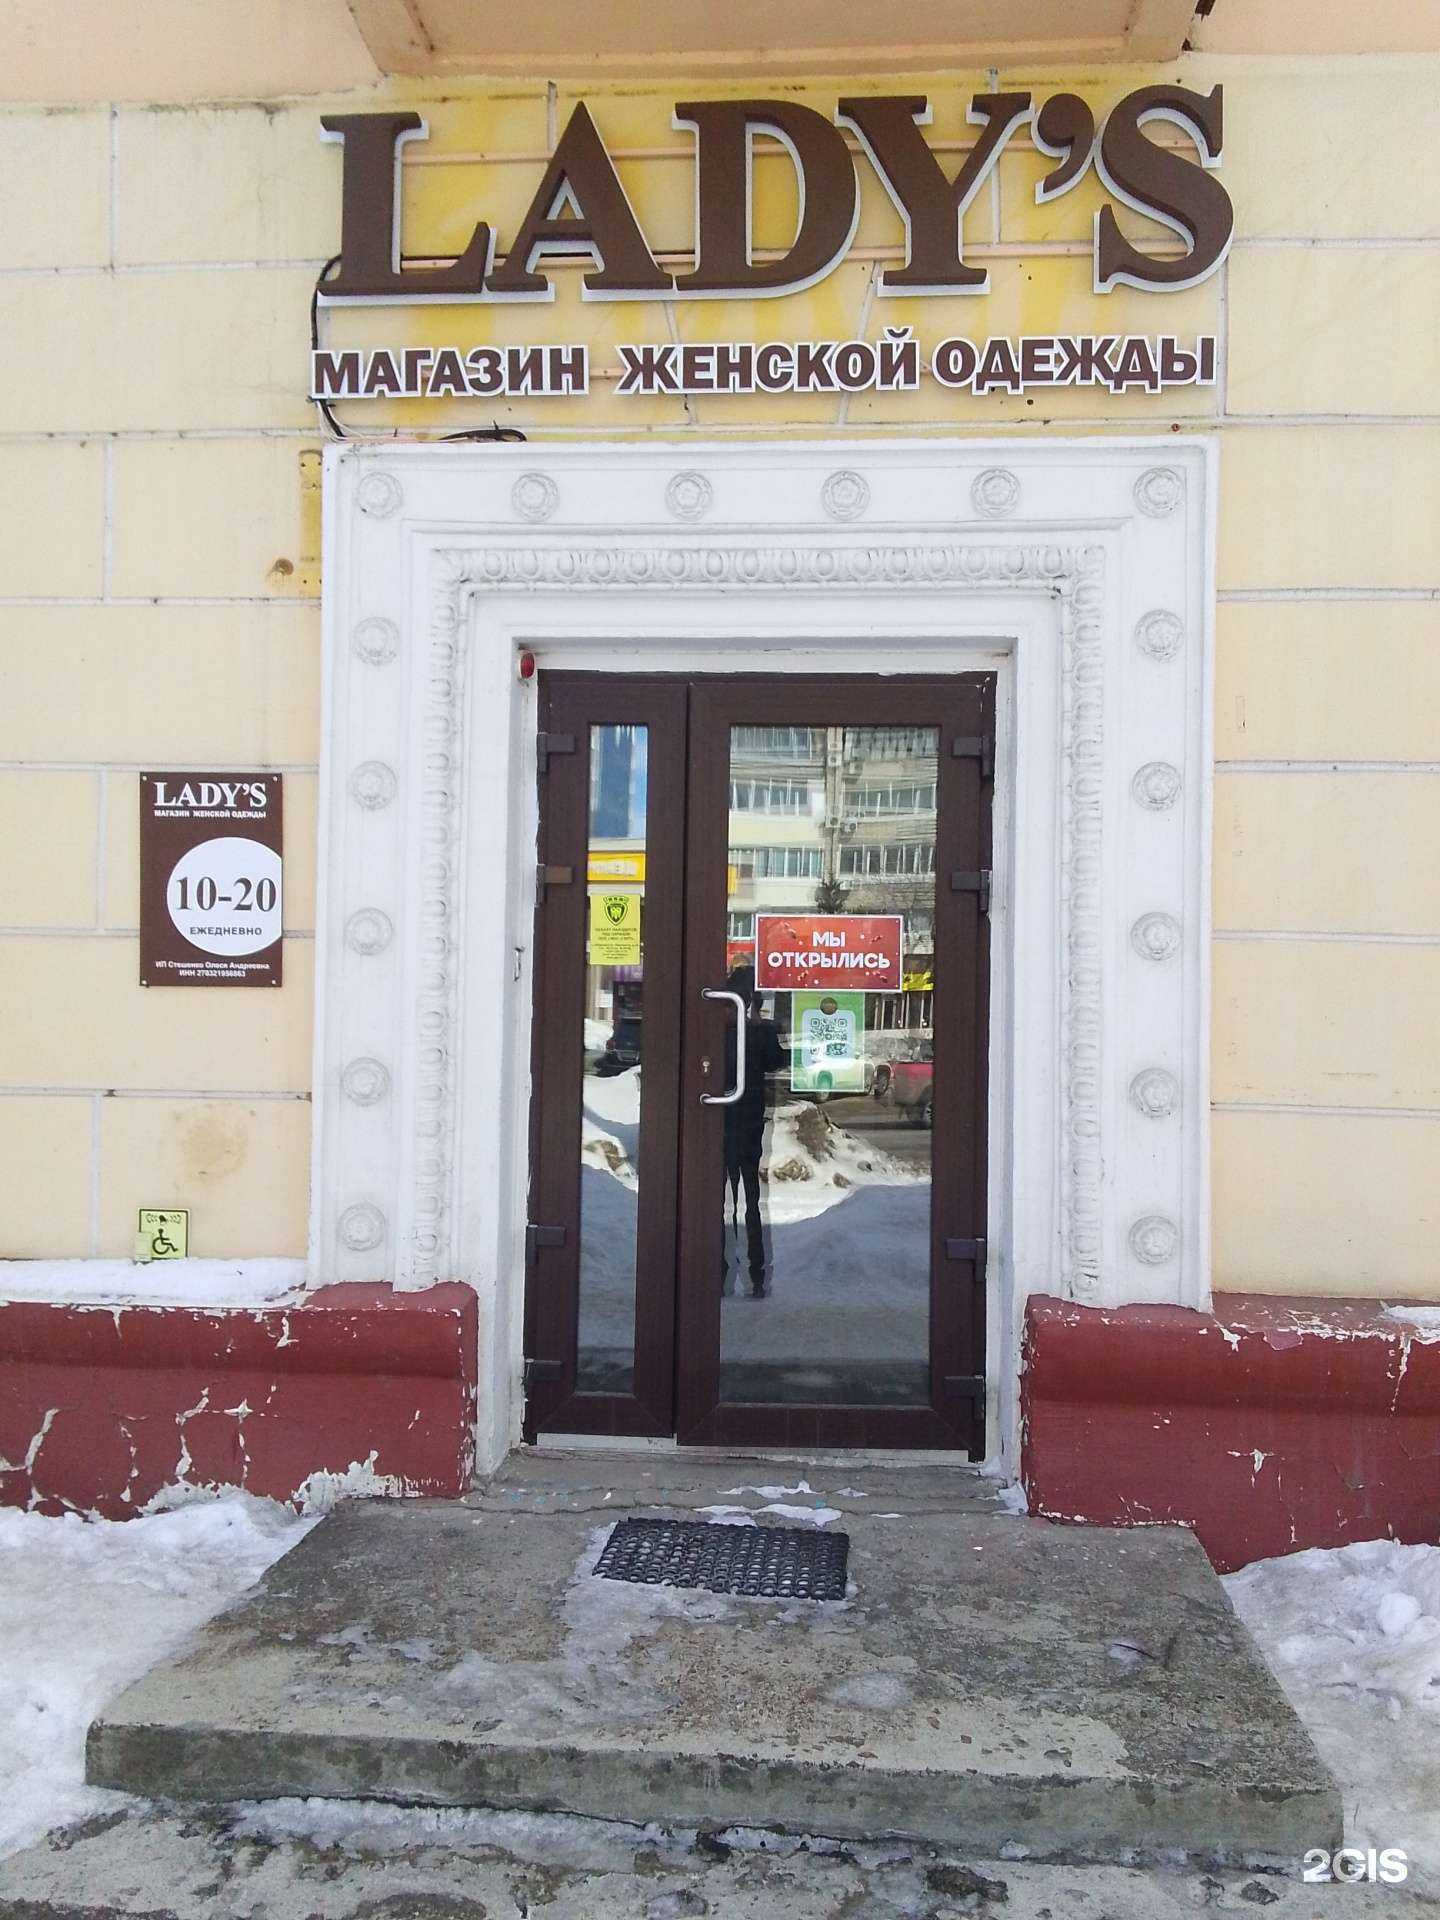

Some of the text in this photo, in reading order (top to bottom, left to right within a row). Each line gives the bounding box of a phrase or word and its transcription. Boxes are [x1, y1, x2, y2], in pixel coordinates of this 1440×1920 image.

[311, 326, 1218, 400] МАГАЗИН ЖЕНСКОЙ ОДЕЖДЫ
[154, 808, 267, 819] МАГАЗИН ЖЕНСКОЙ ОДЕЖДЫ
[175, 876, 277, 913] 10-20
[189, 926, 262, 936] ЕЖЕДНЕВНО
[812, 931, 846, 948] МЫ
[155, 960, 167, 969] ИП
[767, 951, 891, 969] ОТКРЫЛИСЬ
